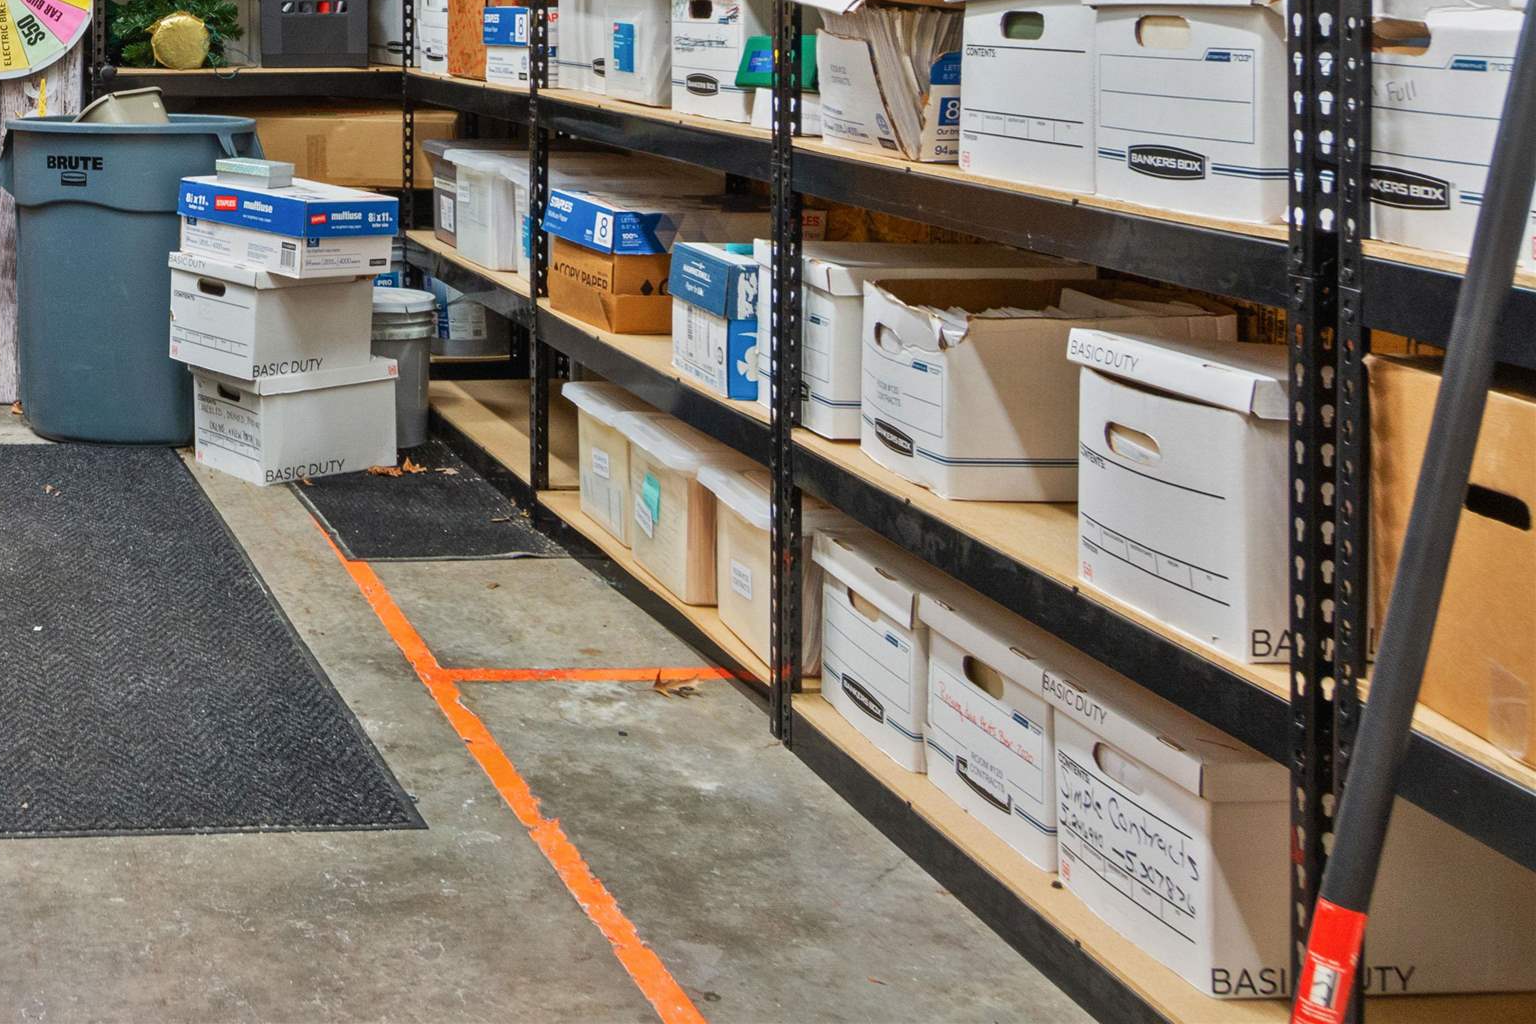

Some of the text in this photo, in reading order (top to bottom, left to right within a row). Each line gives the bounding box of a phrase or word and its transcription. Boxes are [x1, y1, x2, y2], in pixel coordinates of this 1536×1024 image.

[44, 4, 63, 22] EAR
[16, 14, 46, 47] $50
[0, 24, 12, 67] ELECTRIC
[966, 47, 996, 58] CONTENTS:
[1386, 80, 1417, 102] Full
[945, 100, 960, 120] 8
[934, 145, 948, 156] 94
[47, 155, 104, 172] BRUTE
[1130, 152, 1202, 172] BANKERS BOX
[1409, 186, 1445, 202] BOX
[243, 200, 273, 214] multiuse
[330, 210, 363, 221] multiuse
[1070, 339, 1140, 373] BASIC DUTY
[253, 357, 324, 378] BASIC DUTY
[265, 459, 346, 483] BASIC DUTY
[1042, 671, 1075, 708] BASIC
[1073, 690, 1108, 726] DUTY
[1107, 796, 1200, 882] Contracts
[1211, 967, 1286, 995] BASI
